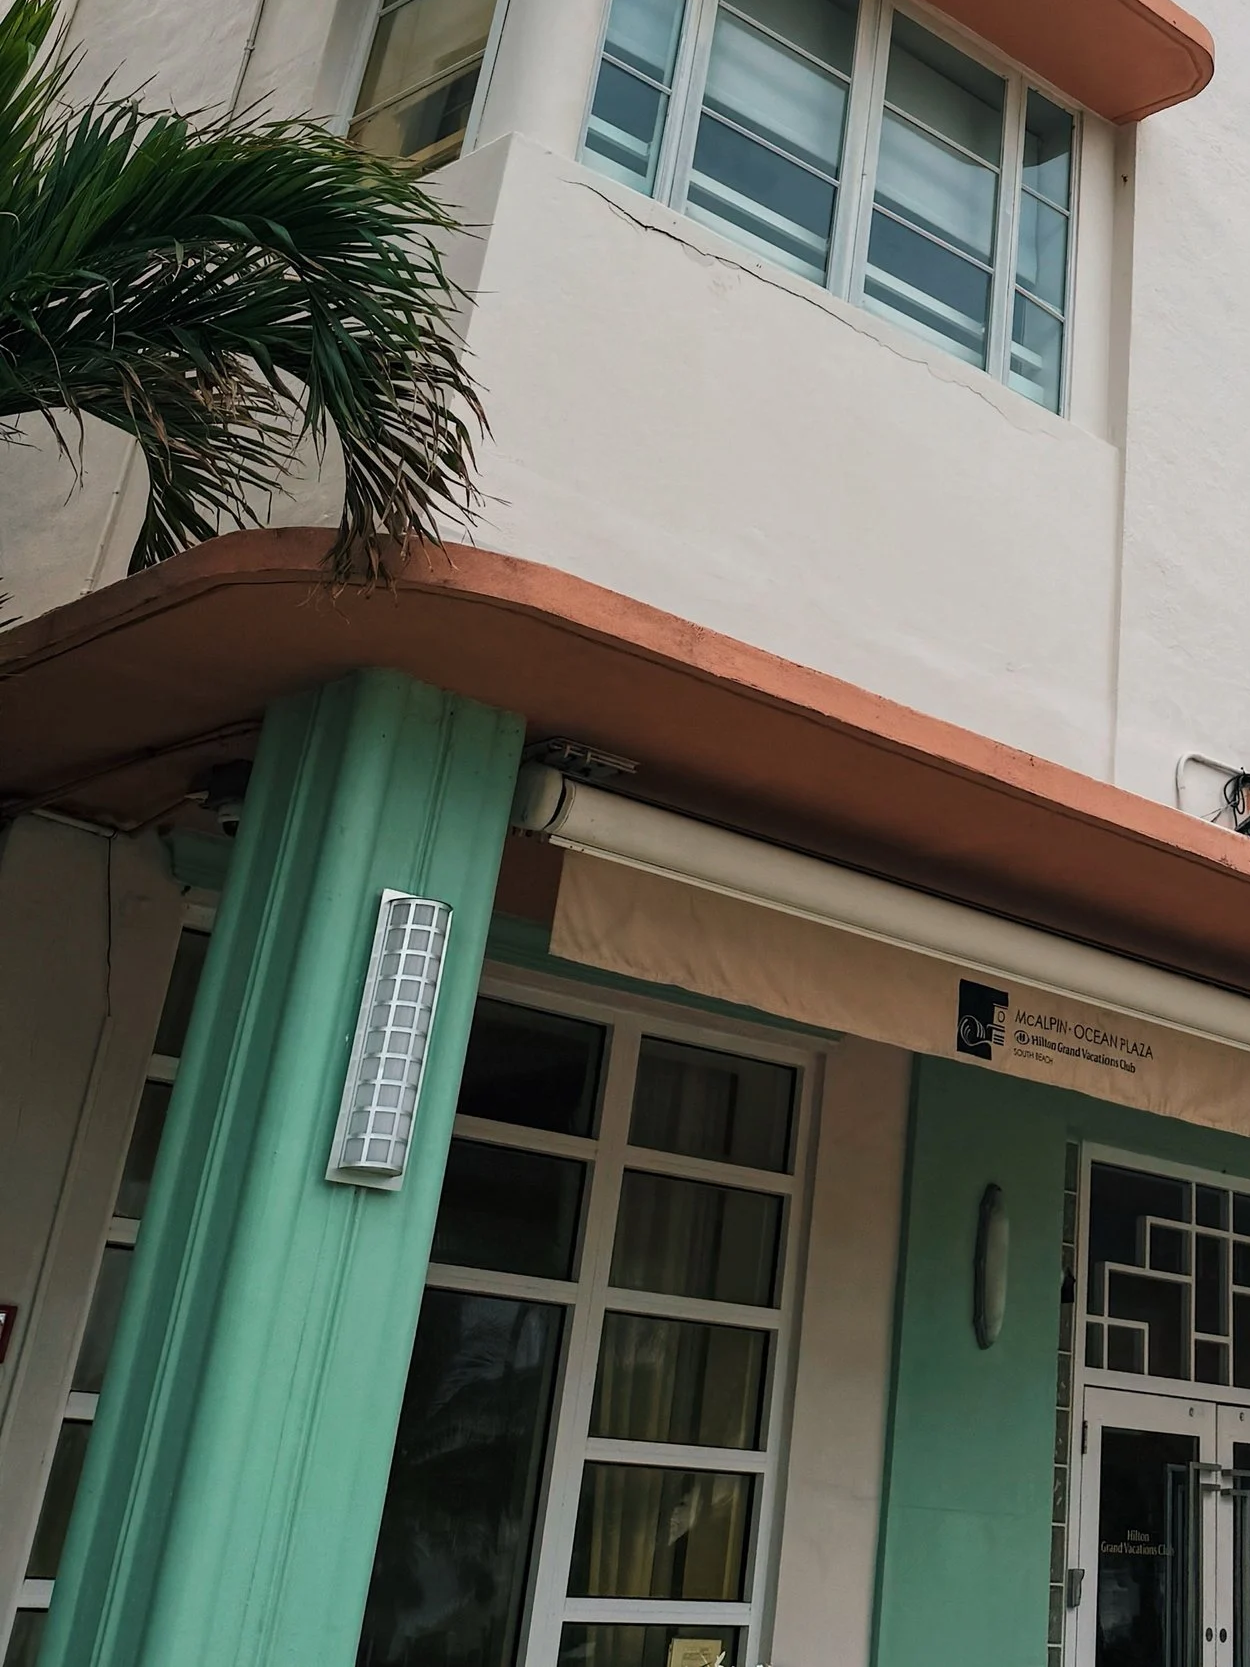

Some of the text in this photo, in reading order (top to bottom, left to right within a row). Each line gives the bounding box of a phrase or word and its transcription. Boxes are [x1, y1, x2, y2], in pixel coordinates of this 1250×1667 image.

[1073, 1024, 1118, 1049] OCEAN
[1119, 1037, 1154, 1060] PLAZA
[1013, 1047, 1054, 1066] SOUTH BEACH
[1031, 1035, 1136, 1074] Hilton Grand Vacations Club
[1127, 1529, 1150, 1542] Hilton
[1100, 1540, 1123, 1554] Grand
[1123, 1542, 1157, 1555] Vacations
